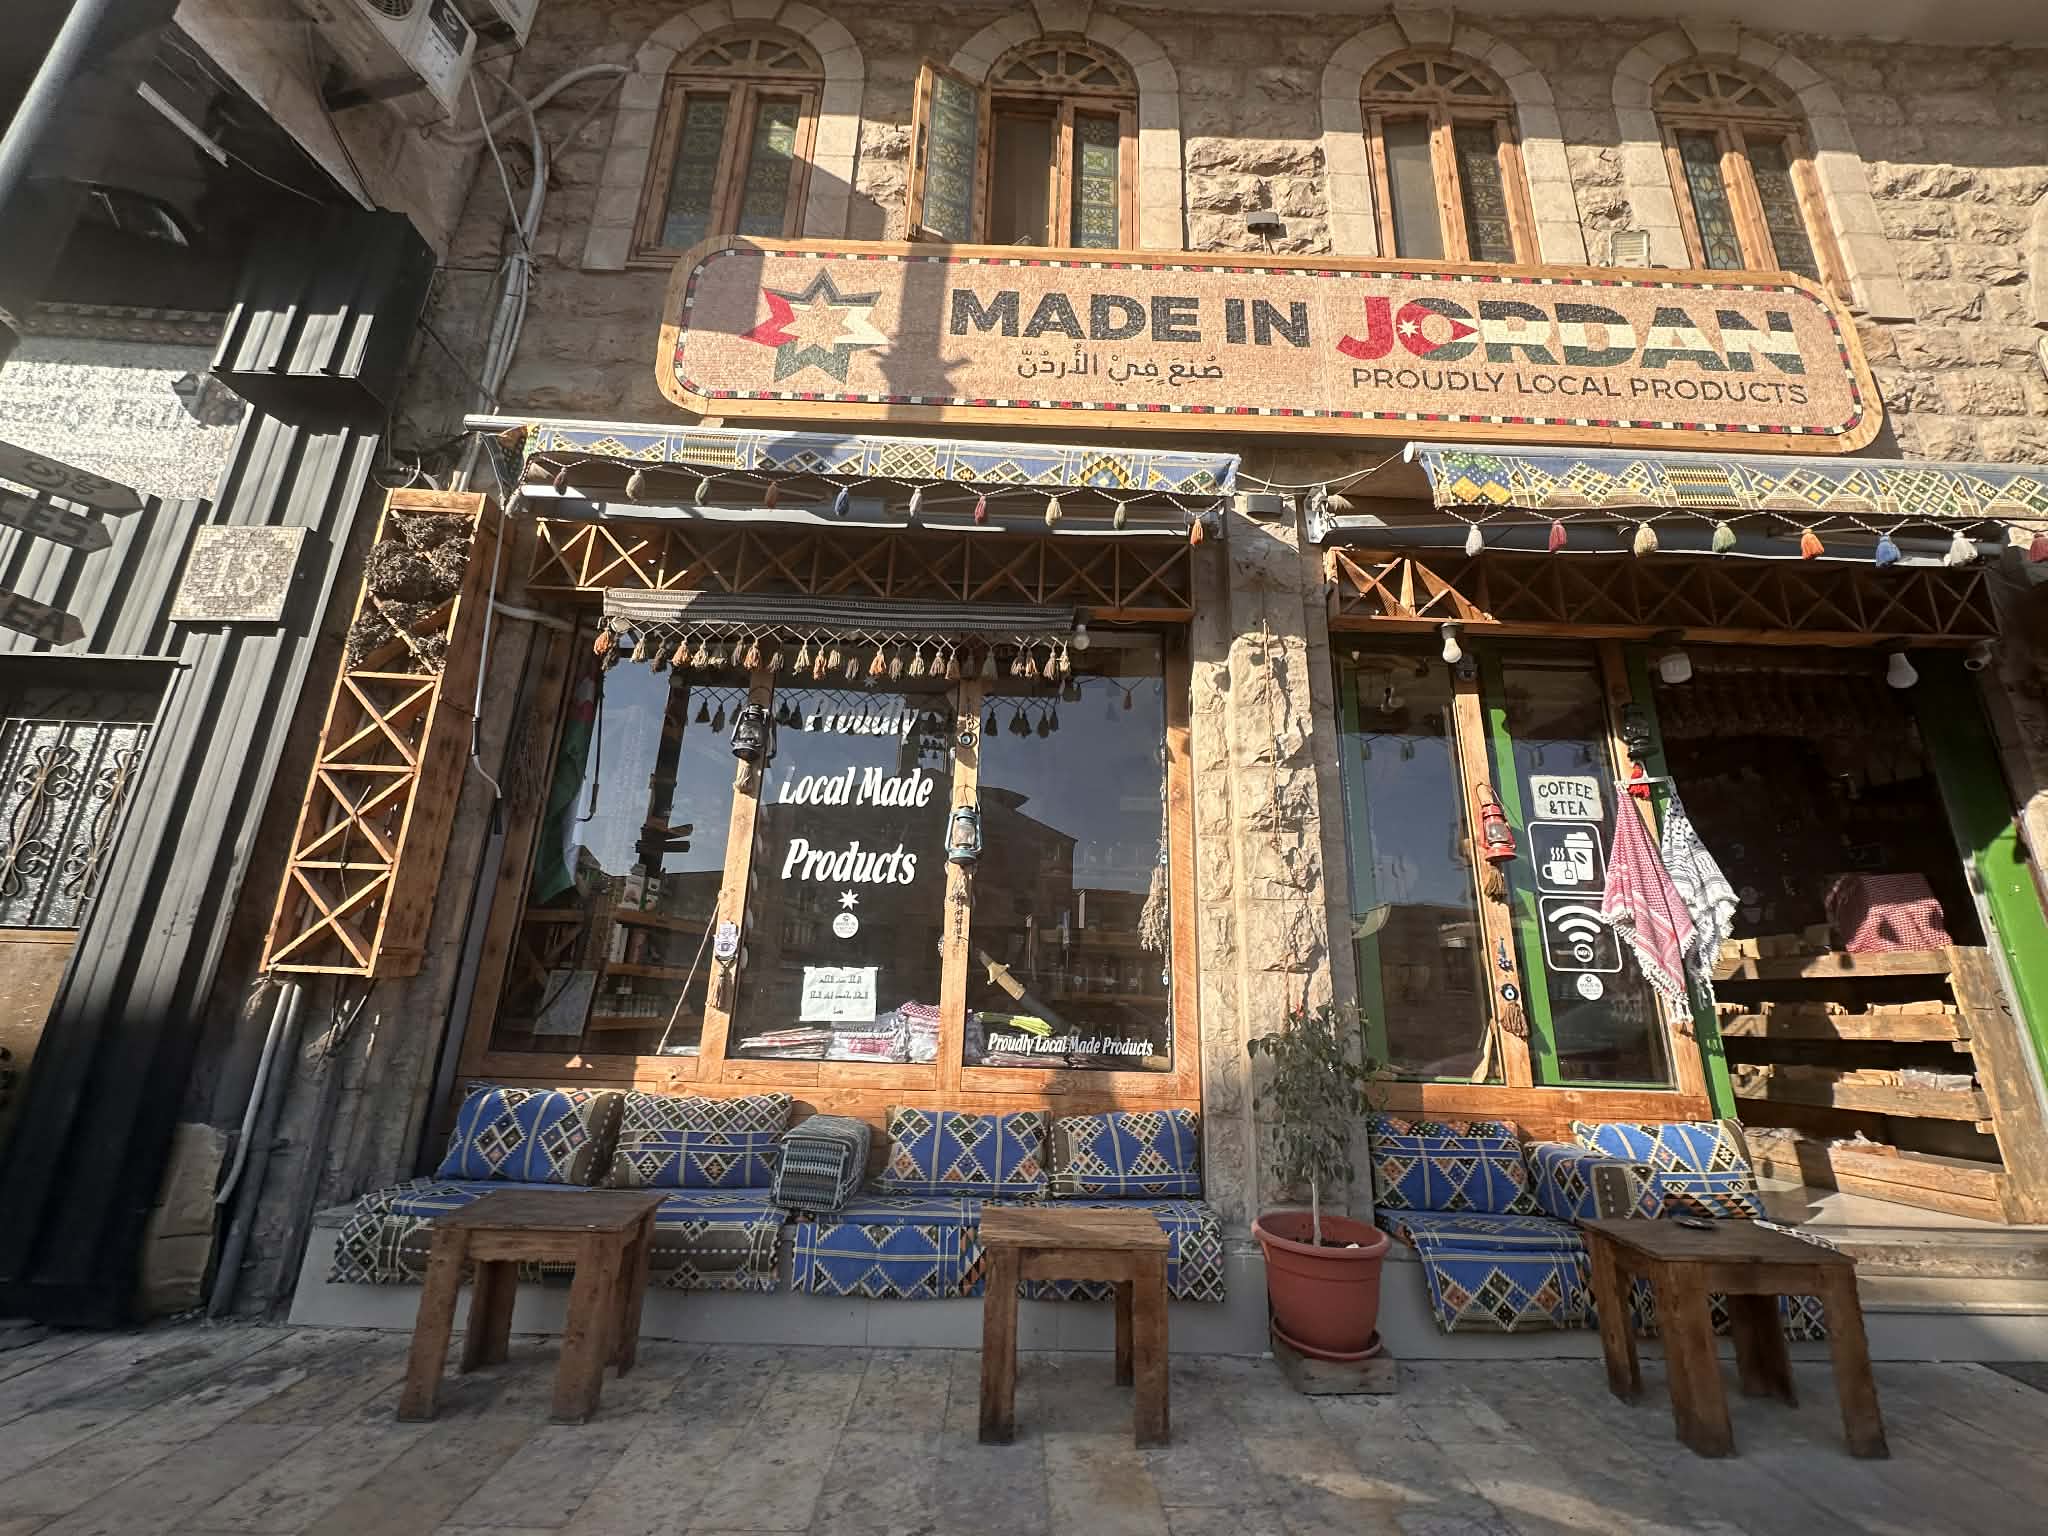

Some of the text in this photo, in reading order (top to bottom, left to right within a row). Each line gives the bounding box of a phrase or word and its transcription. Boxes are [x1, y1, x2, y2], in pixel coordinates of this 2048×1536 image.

[950, 288, 1806, 375] MADE IN JORDAN
[1353, 367, 1808, 405] PROUDLY LOCAL PRODUCTS
[779, 764, 934, 807] Local Made
[1538, 781, 1593, 800] COFFEE
[1549, 800, 1588, 816] &TEA
[781, 838, 917, 885] Products
[988, 1033, 1154, 1057] Proudly Local Made Products
